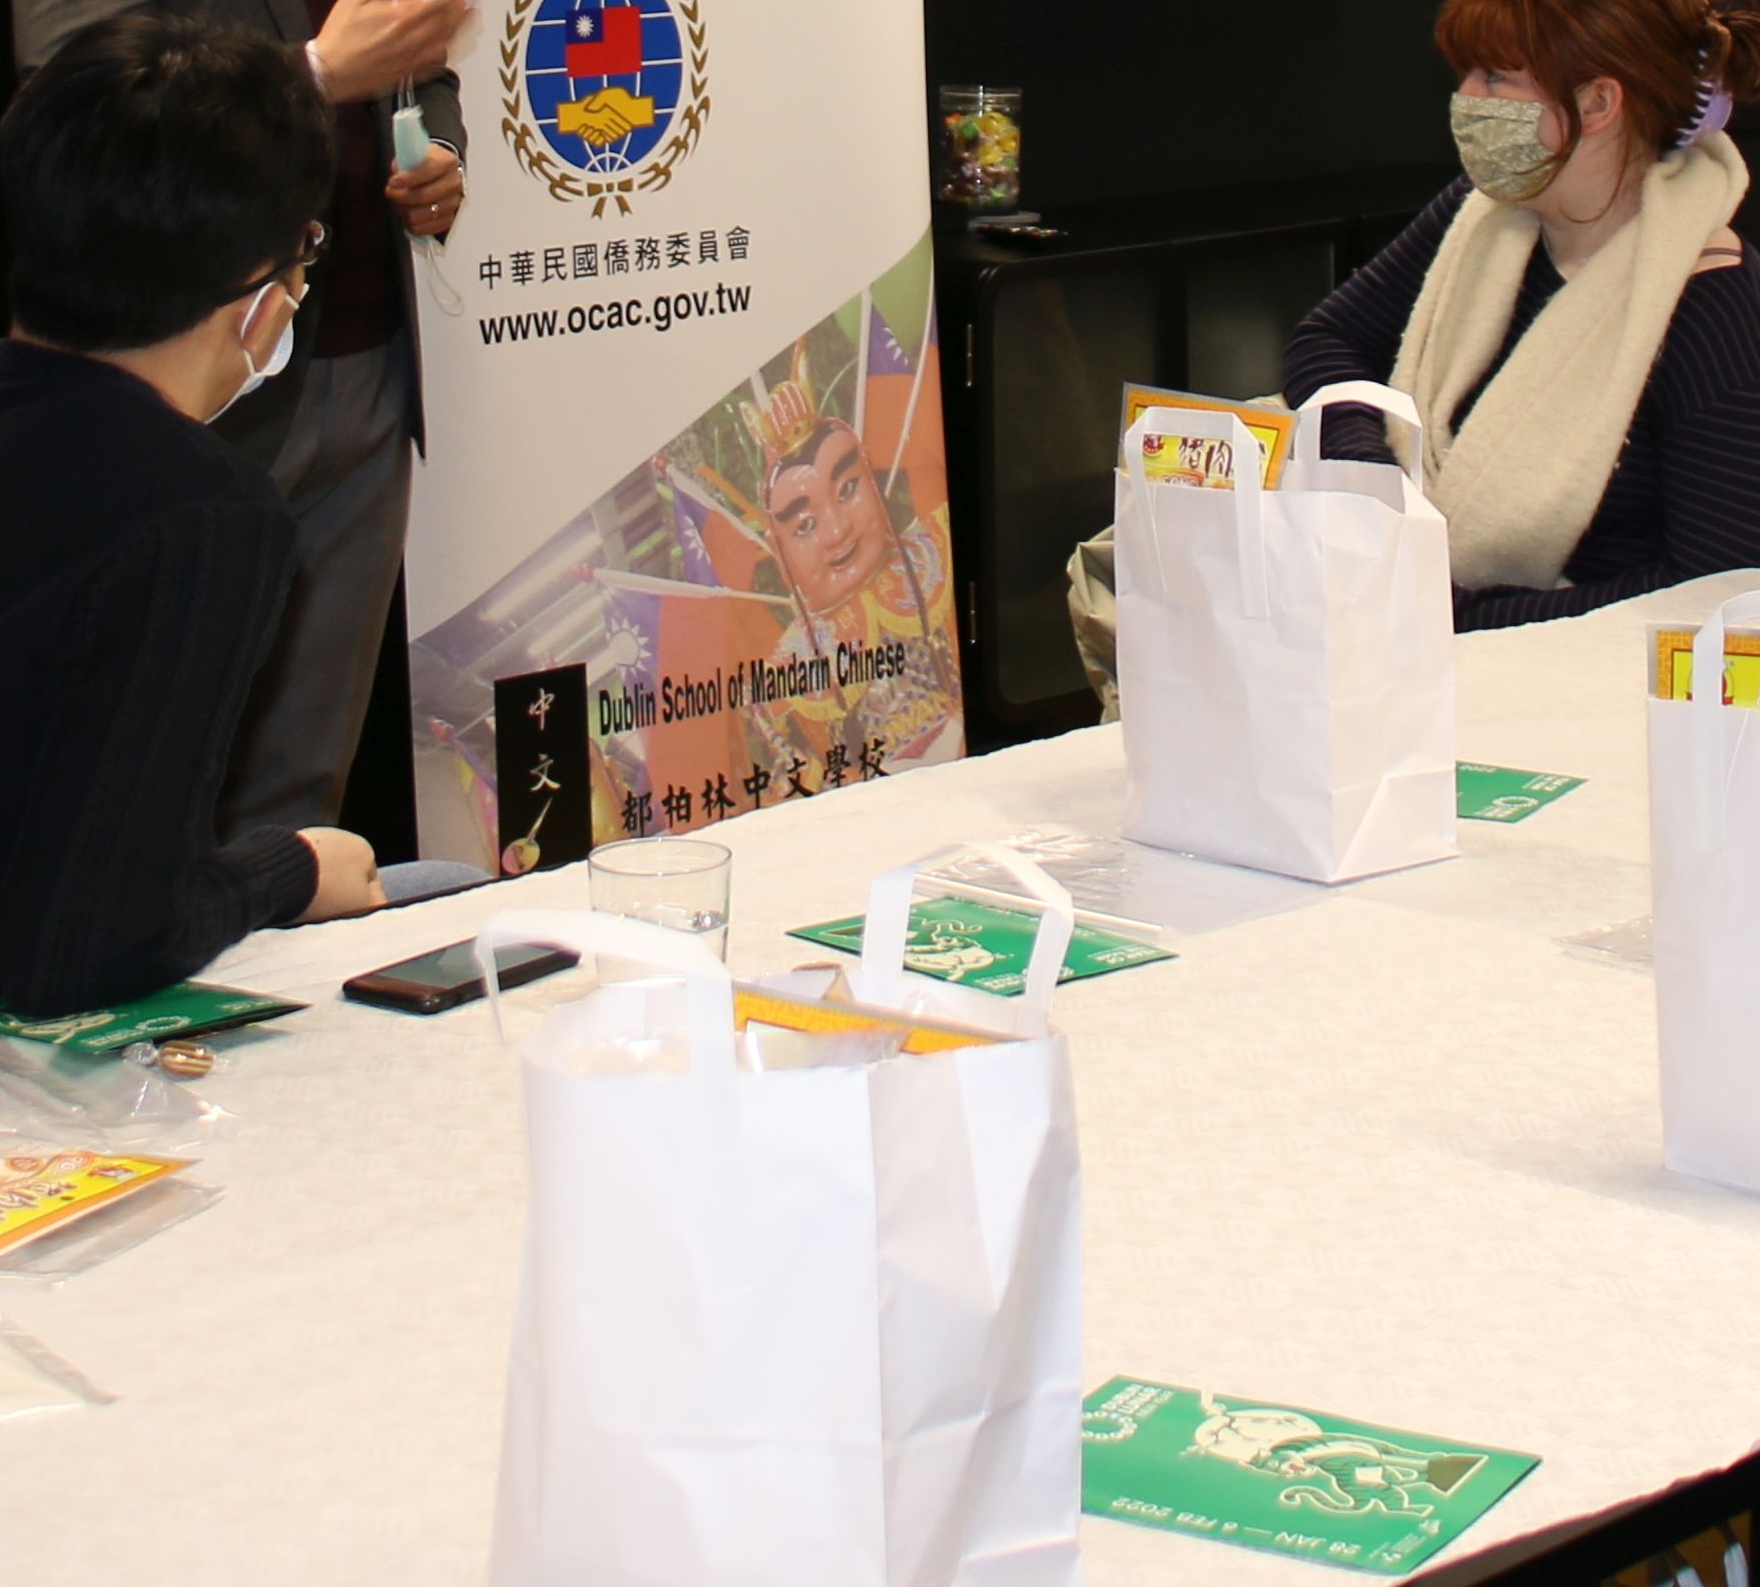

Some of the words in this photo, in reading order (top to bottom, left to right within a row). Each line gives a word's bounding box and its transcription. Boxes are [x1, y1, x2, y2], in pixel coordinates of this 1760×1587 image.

[478, 225, 752, 290] 中華民國僑務委員會
[480, 282, 752, 345] www.ocac.gov.tw
[599, 684, 656, 736] Dublin
[662, 672, 722, 725] School
[727, 670, 744, 710] of
[750, 649, 831, 704] Mandarin
[836, 640, 906, 687] Chinese
[620, 739, 890, 833] 都柏林中文學校
[1112, 1496, 1173, 1517] 2022
[1176, 1511, 1218, 1529] FEB
[1221, 1521, 1239, 1533] 6
[1274, 1531, 1328, 1549] JAN
[1328, 1541, 1362, 1555] 28
